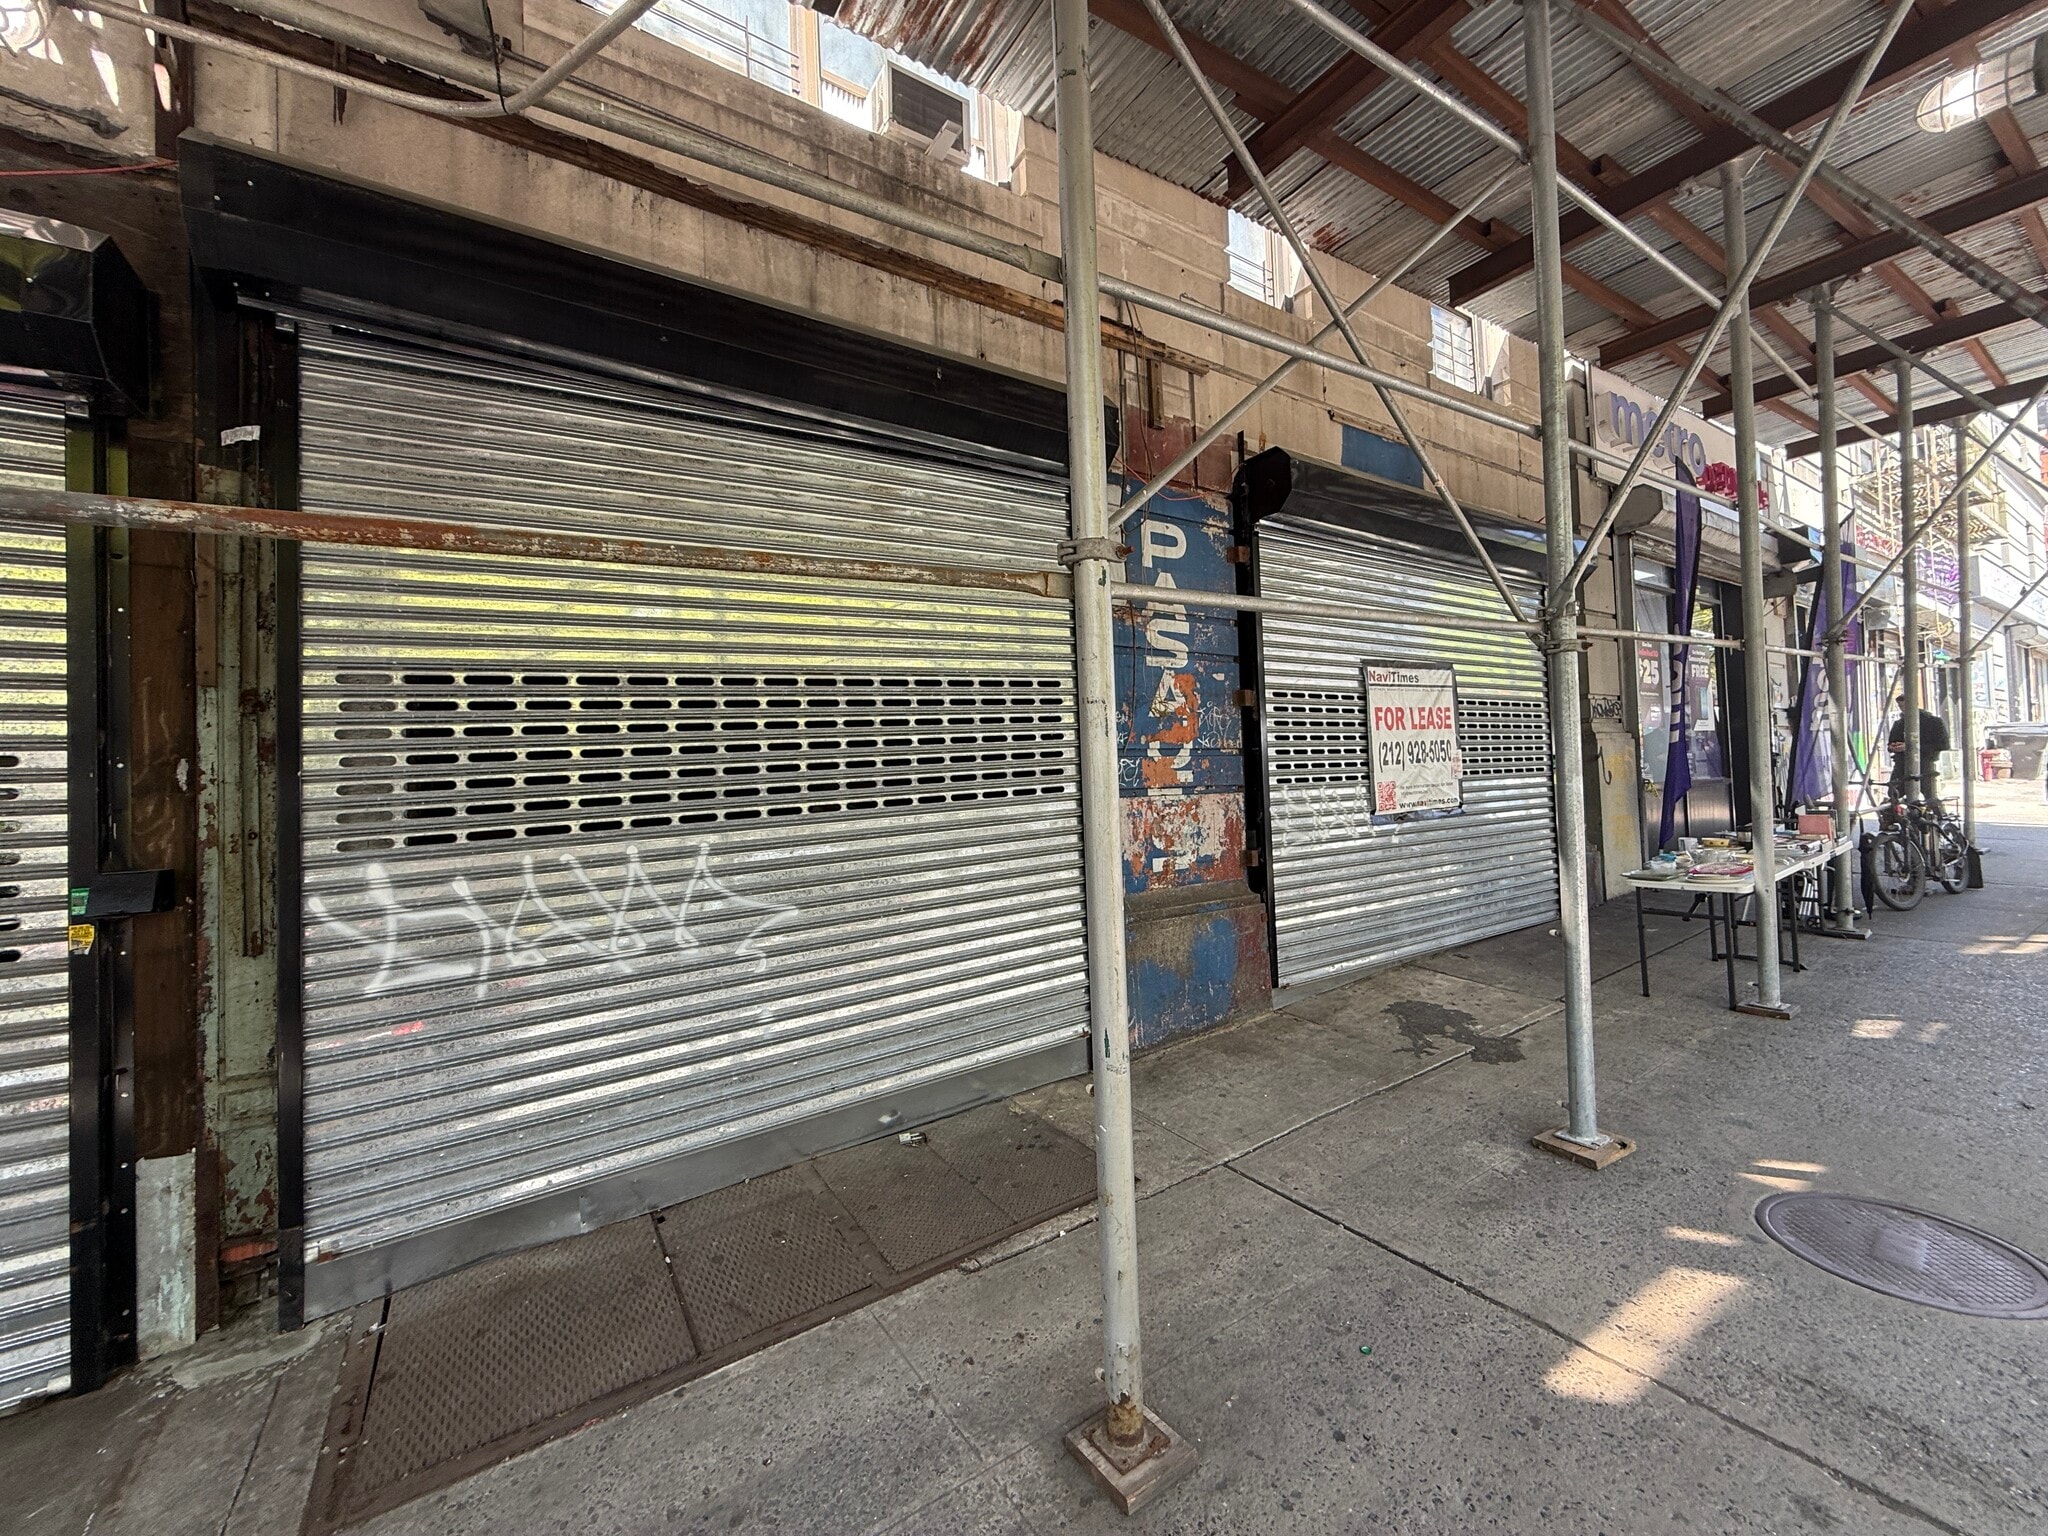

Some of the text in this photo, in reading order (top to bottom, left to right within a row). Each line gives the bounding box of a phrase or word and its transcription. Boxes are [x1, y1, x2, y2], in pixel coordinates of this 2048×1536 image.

[1368, 670, 1420, 684] NaviTimes
[1690, 663, 1710, 679] FREE
[1374, 706, 1453, 731] FOR LEASE
[1378, 740, 1405, 773] (212)
[1407, 739, 1452, 765] 928-5050
